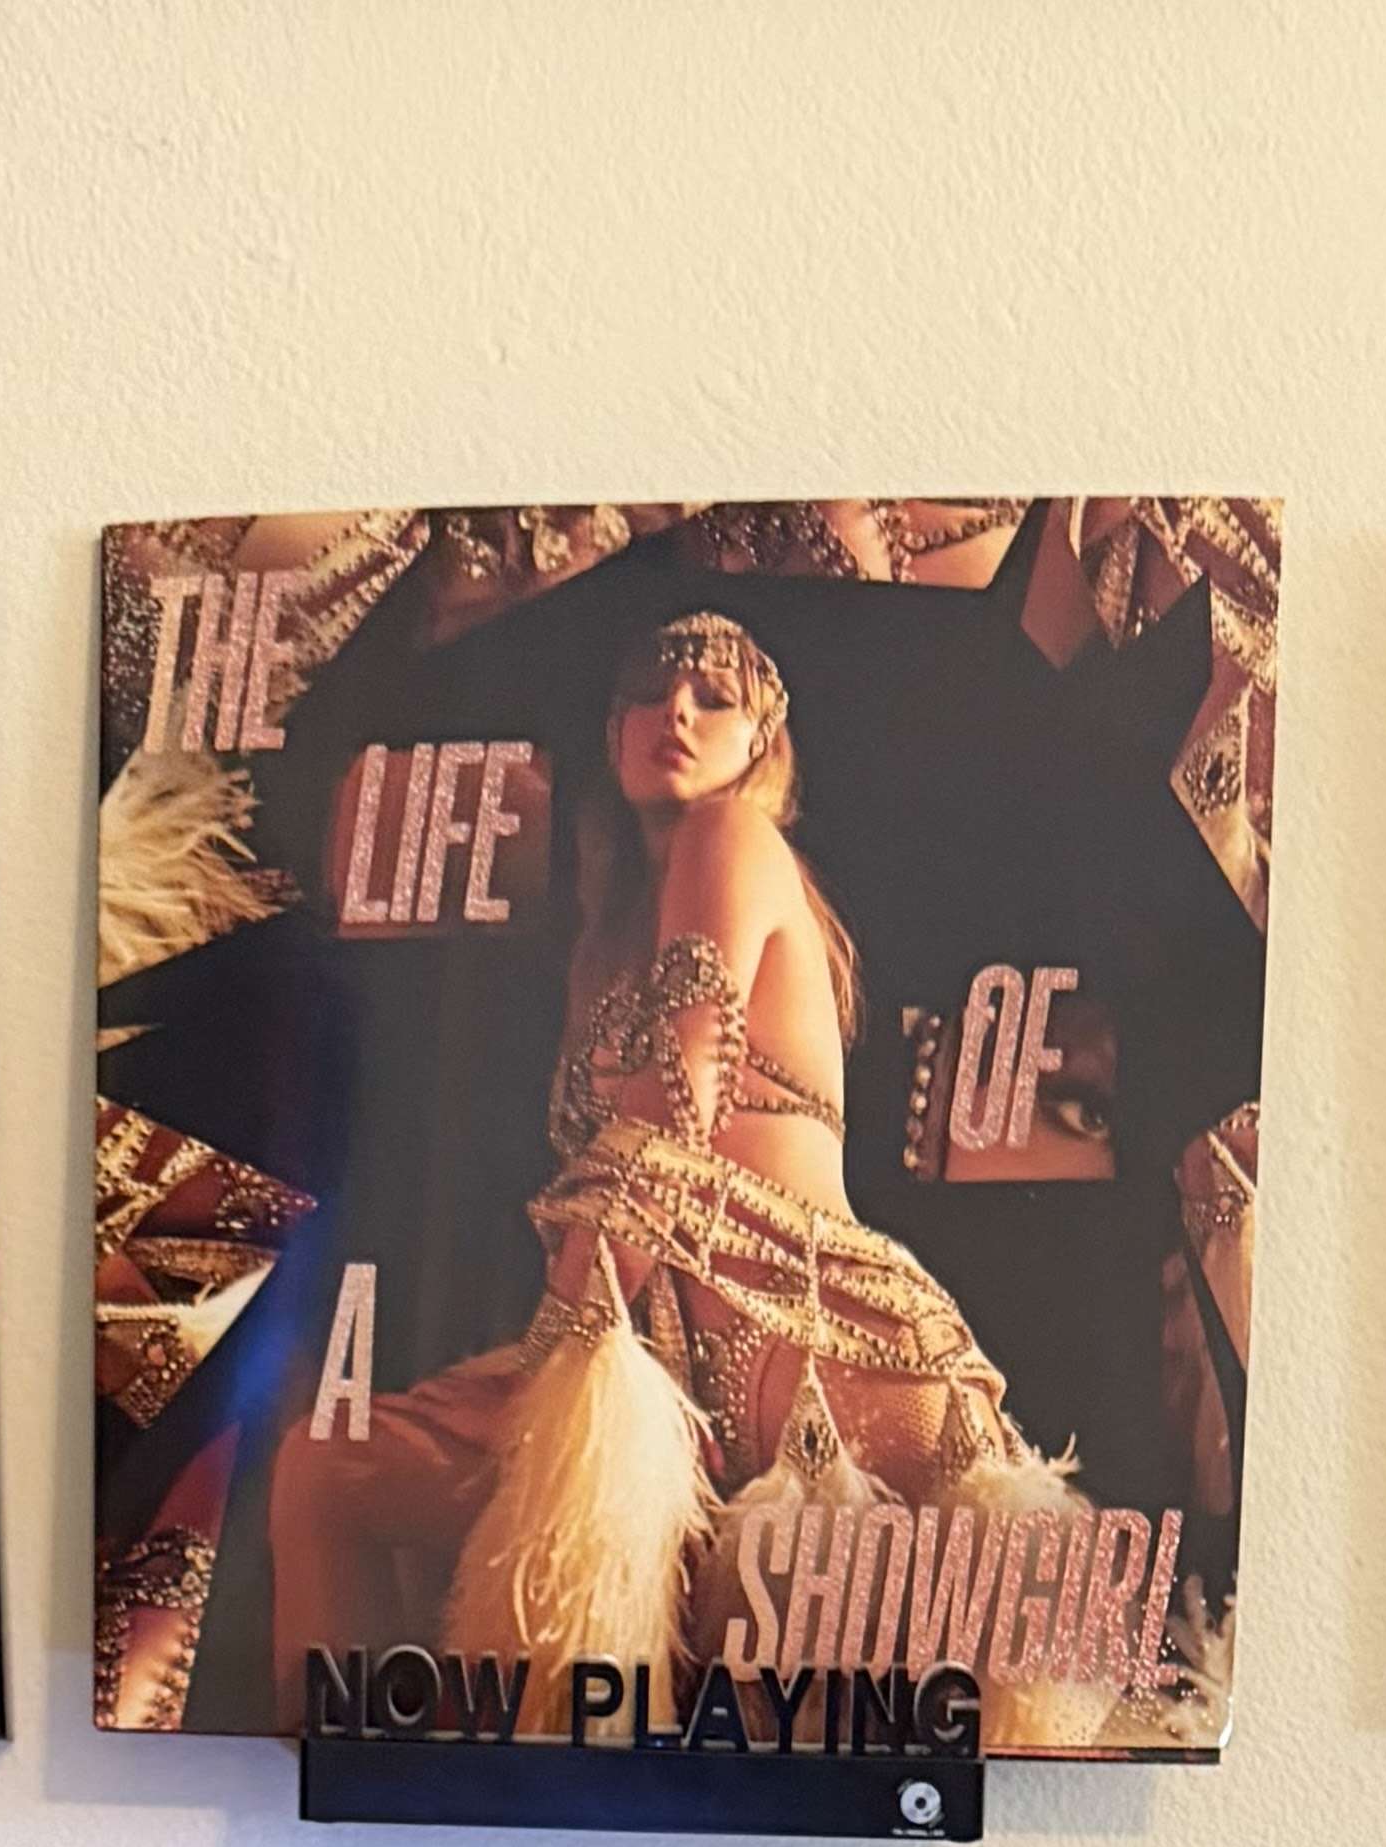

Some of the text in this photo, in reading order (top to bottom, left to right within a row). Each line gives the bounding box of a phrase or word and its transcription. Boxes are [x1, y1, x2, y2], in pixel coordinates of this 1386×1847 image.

[144, 570, 302, 752] THE
[343, 741, 533, 924] LIFE
[952, 964, 1079, 1153] OF
[310, 1262, 377, 1443] A
[724, 1504, 1184, 1687] SHOWGIRL
[307, 1644, 982, 1758] NOW PLAYING
